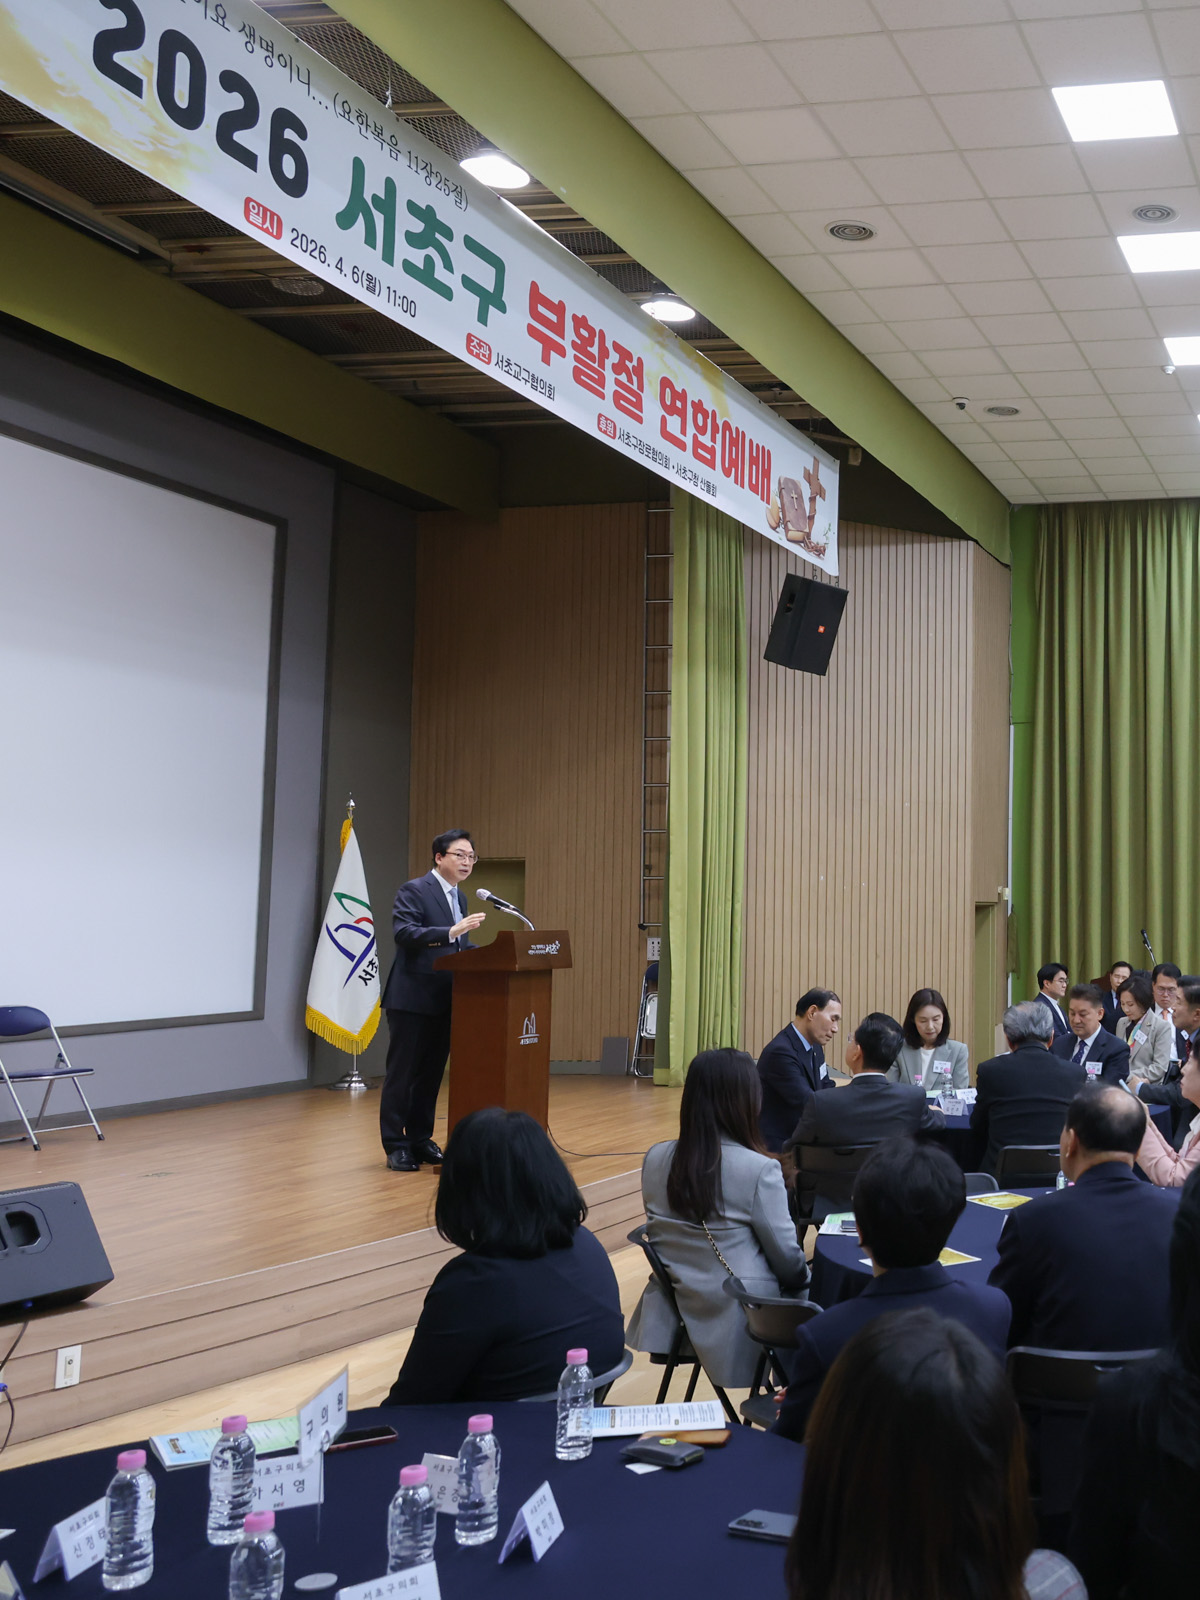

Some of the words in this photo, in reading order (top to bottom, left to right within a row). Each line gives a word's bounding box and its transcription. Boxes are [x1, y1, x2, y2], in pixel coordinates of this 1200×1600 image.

[333, 92, 402, 162] (요한복음
[406, 150, 469, 213] 11장25절)
[93, 0, 309, 198] 2026
[335, 155, 508, 328] 서초구
[527, 280, 645, 425] 부활절
[658, 375, 772, 506] 연합예배
[249, 201, 278, 237] 일시
[290, 227, 331, 268] 2026.
[335, 256, 347, 278] 4.
[351, 265, 382, 298] 6(월)
[386, 286, 417, 319] 11:00
[469, 335, 490, 365] 주관
[494, 352, 556, 402] 서초교구협의회
[599, 416, 615, 437] 후원
[363, 1575, 418, 1600] 서초구의회
